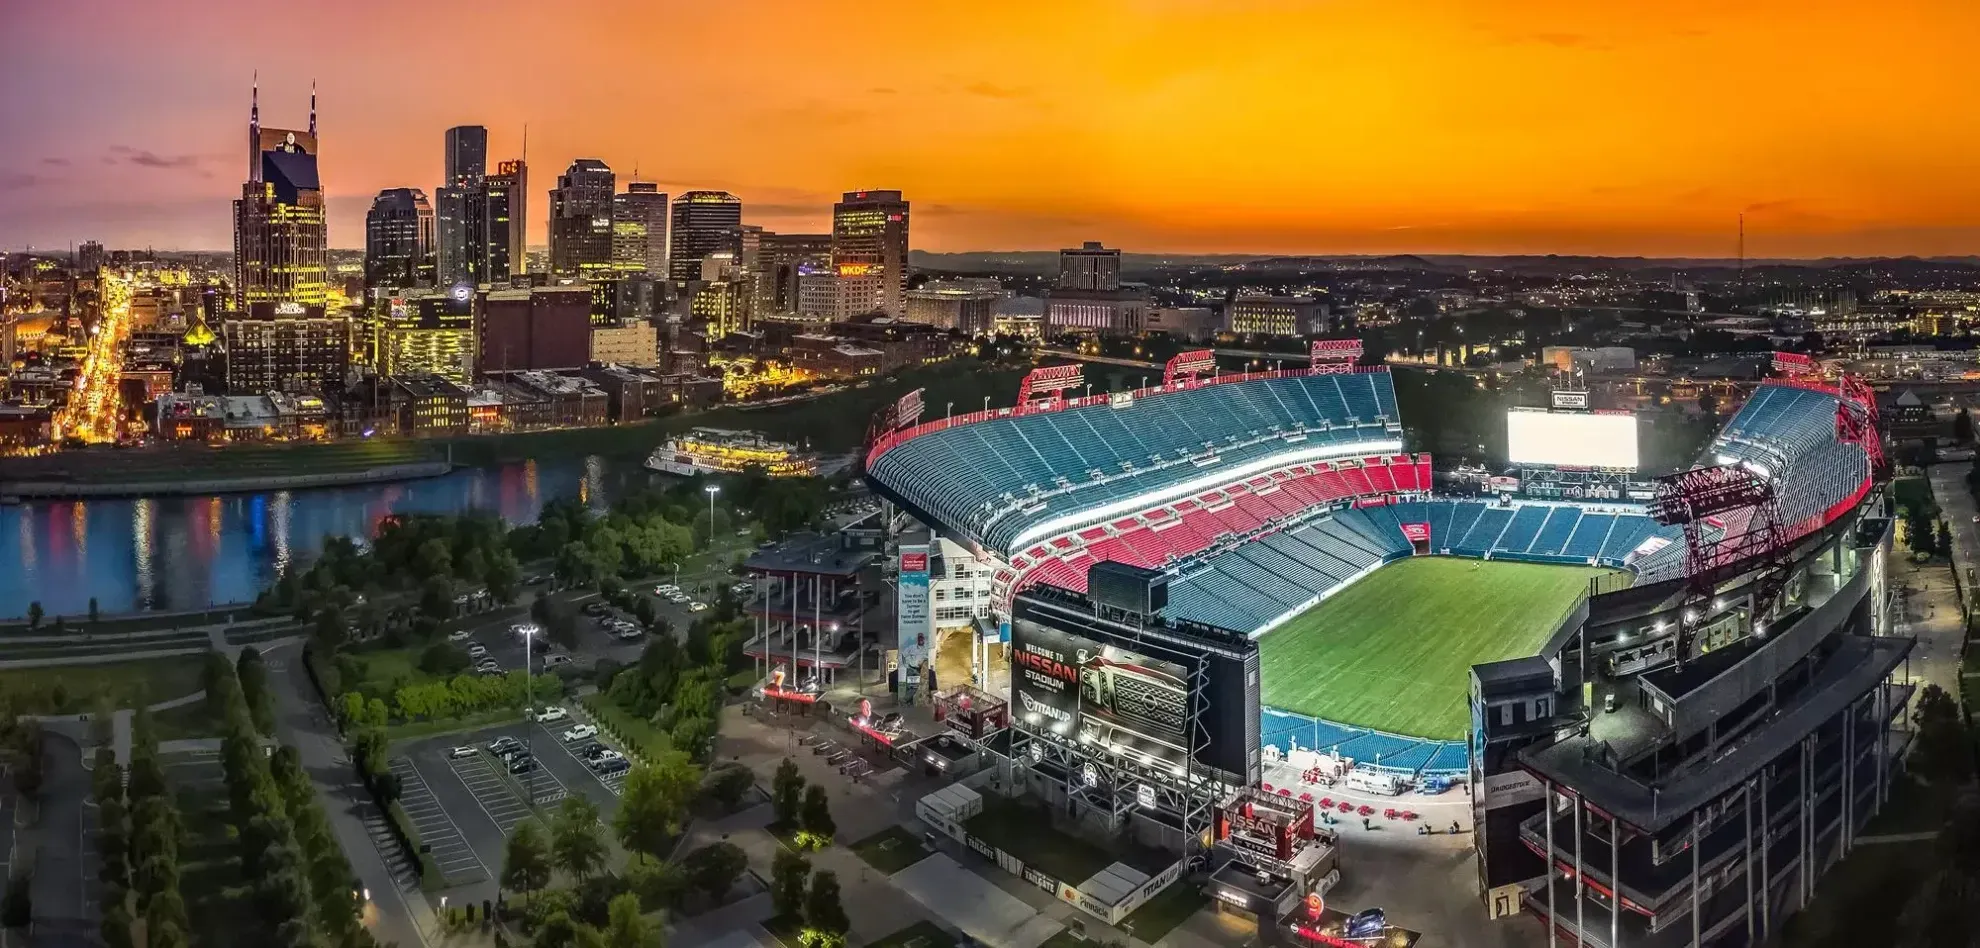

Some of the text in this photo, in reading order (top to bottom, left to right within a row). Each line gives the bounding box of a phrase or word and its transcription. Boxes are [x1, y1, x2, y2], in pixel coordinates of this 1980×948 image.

[840, 265, 868, 276] WKDF
[1025, 643, 1064, 662] WELCOME TO
[1014, 648, 1077, 683] NISSAN
[1025, 669, 1064, 690] STADIUM
[1222, 810, 1276, 835] NISSAN
[1245, 841, 1276, 856] TITAN
[1024, 869, 1054, 893] TAILGATE
[1080, 896, 1109, 919] Pinnacle
